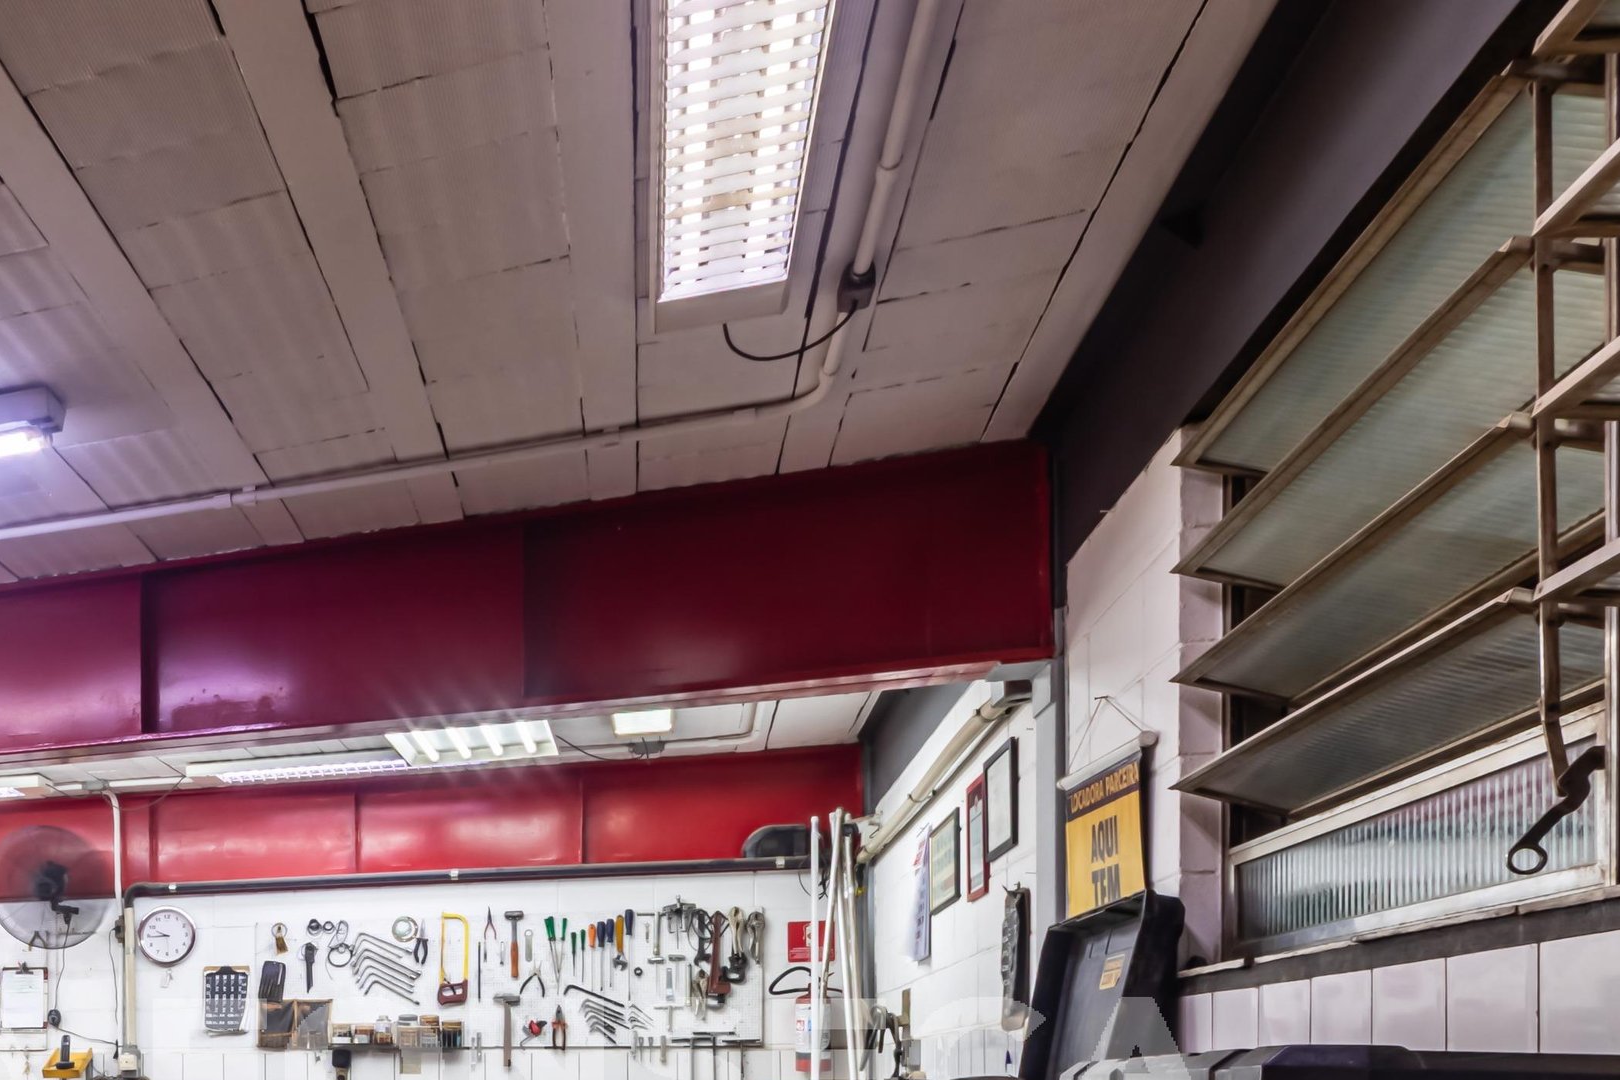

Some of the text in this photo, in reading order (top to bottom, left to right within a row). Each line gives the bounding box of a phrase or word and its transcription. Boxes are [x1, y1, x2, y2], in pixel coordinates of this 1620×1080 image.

[1070, 761, 1140, 813] LOCADORA PARCEIRA
[1091, 815, 1118, 864] AQUI
